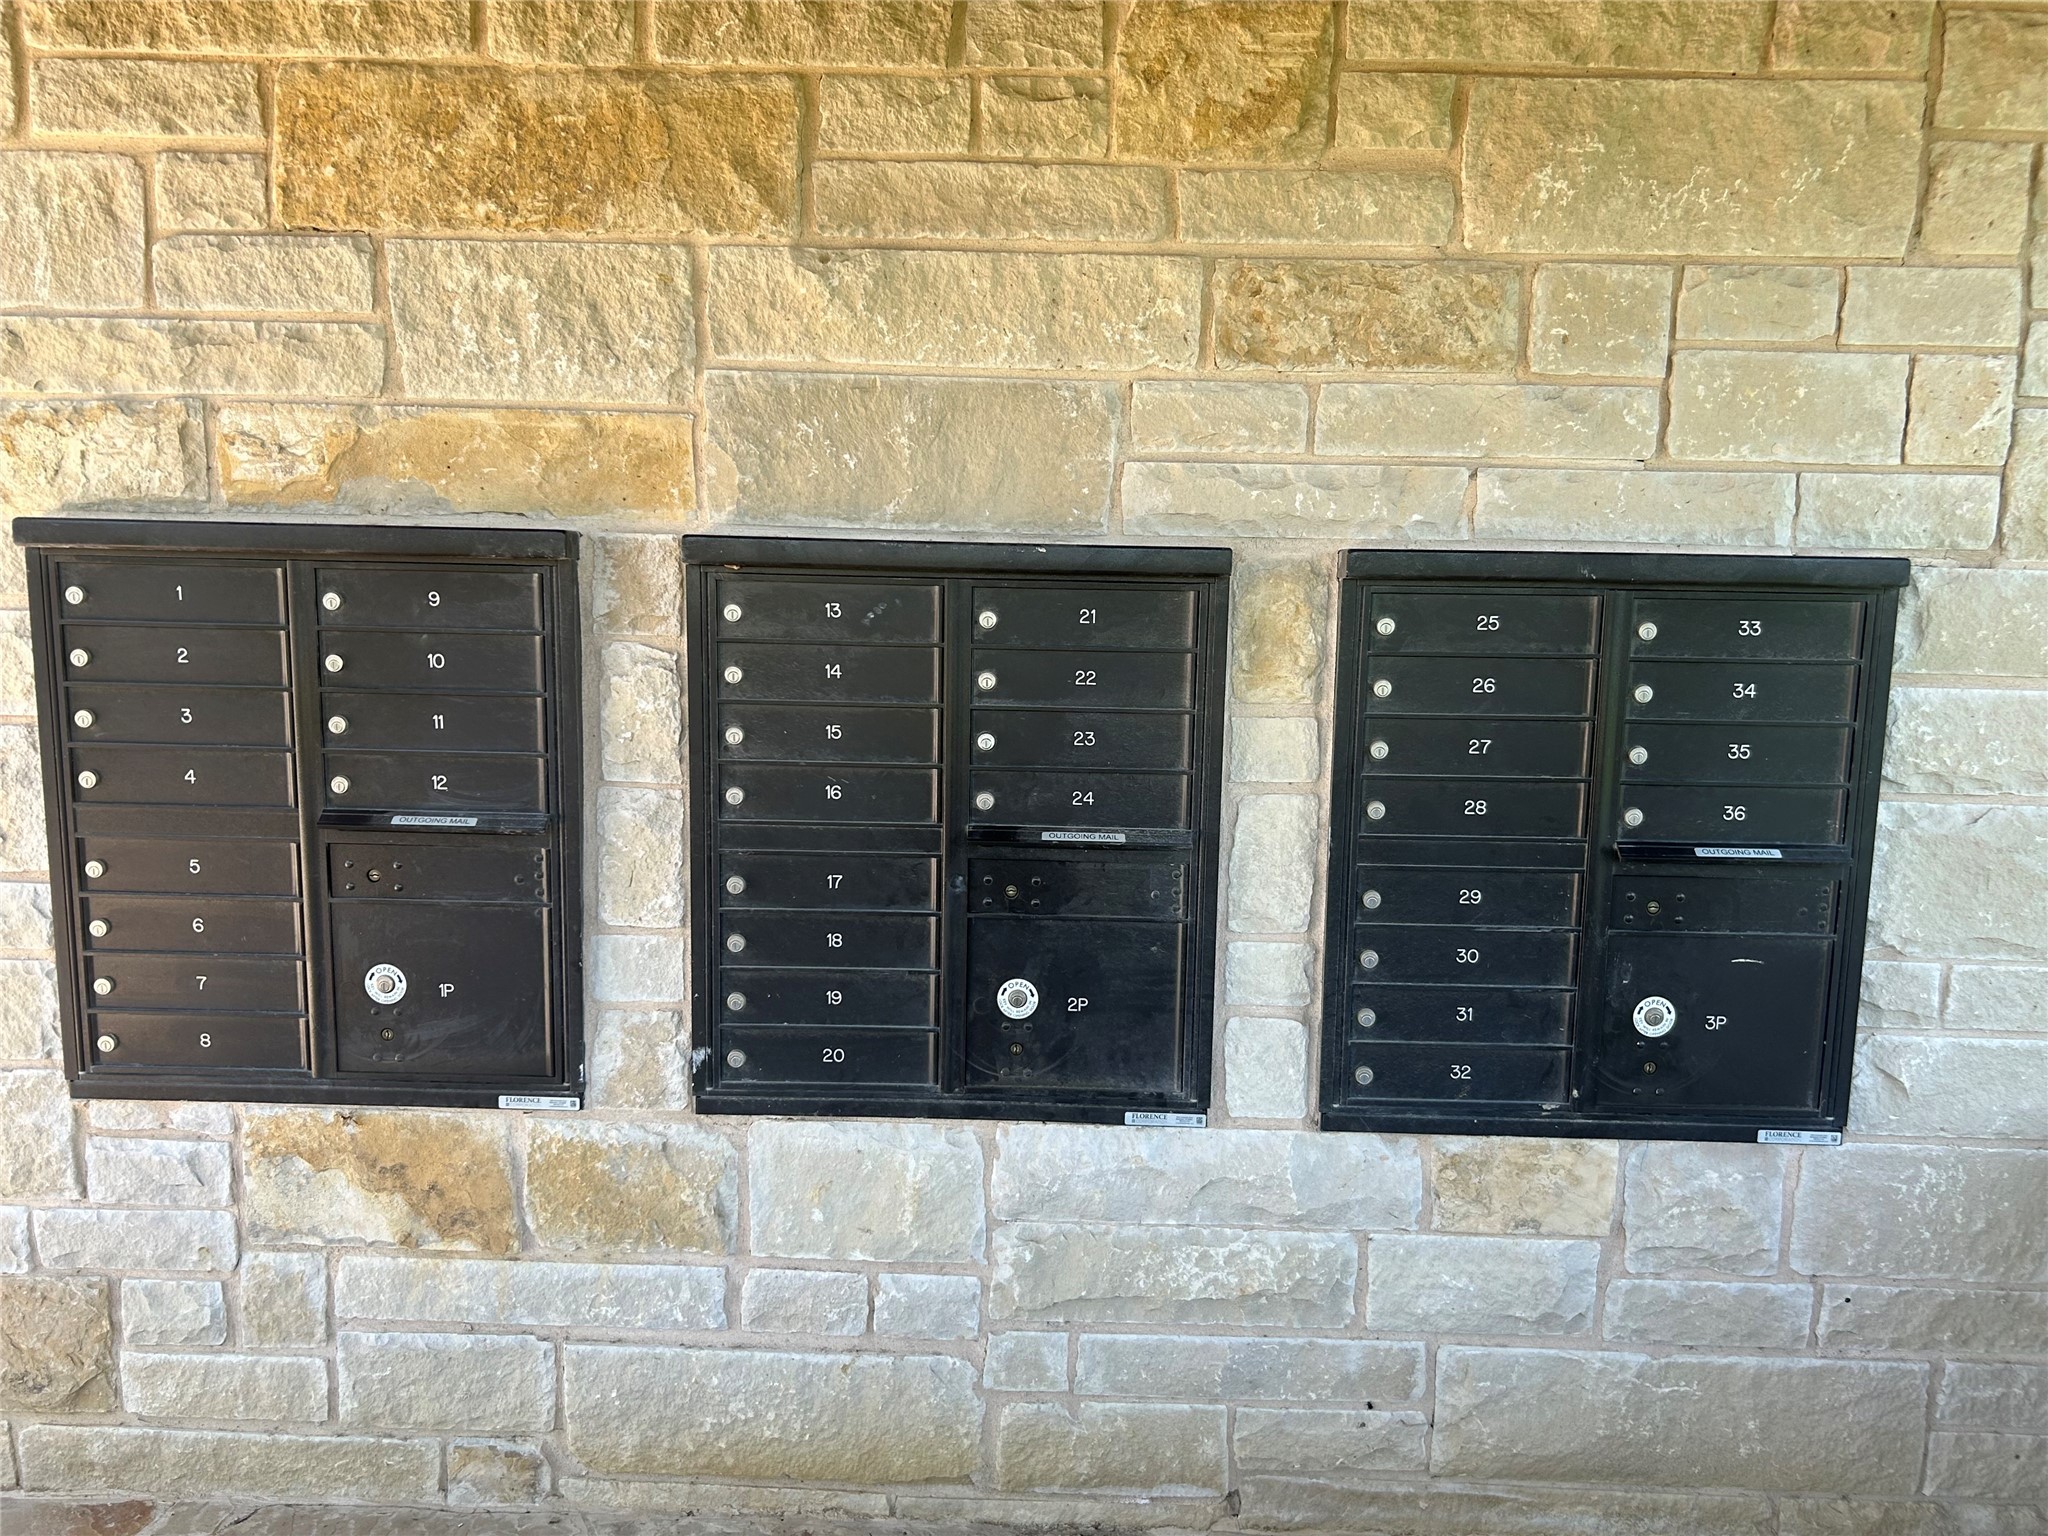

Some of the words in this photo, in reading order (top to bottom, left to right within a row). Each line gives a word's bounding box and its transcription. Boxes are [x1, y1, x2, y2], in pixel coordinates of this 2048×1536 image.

[175, 585, 183, 601] 1
[428, 591, 441, 607] 9
[824, 602, 842, 619] 13
[1079, 608, 1096, 624] 21
[1476, 615, 1500, 631] 25
[1738, 620, 1762, 637] 33
[177, 647, 189, 664] 2
[427, 653, 445, 669] 10
[824, 663, 843, 679] 14
[1075, 670, 1097, 686] 22
[1472, 677, 1496, 693] 26
[1732, 683, 1757, 699] 34
[180, 708, 193, 724] 3
[432, 714, 444, 730] 11
[825, 724, 842, 740] 15
[1073, 731, 1096, 746] 23
[1468, 739, 1492, 755] 27
[1727, 744, 1751, 760] 35
[184, 769, 197, 785] 4
[431, 775, 449, 792] 12
[825, 784, 842, 800] 16
[1072, 791, 1095, 806] 24
[1464, 799, 1487, 815] 28
[1722, 805, 1746, 821] 36
[399, 816, 446, 824] OUTGOING
[1048, 832, 1096, 840] OUTGOING
[1701, 848, 1751, 856] OUTGOING
[1753, 849, 1775, 857] MAIL
[189, 858, 201, 874] 5
[826, 874, 843, 889] 17
[1459, 889, 1482, 905] 29
[192, 917, 205, 933] 6
[826, 933, 843, 948] 18
[1455, 948, 1479, 964] 30
[375, 966, 397, 976] OPEN
[195, 975, 207, 991] 7
[438, 983, 455, 998] 1P
[1008, 981, 1030, 990] OPEN
[826, 990, 843, 1005] 19
[1067, 997, 1089, 1012] 2P
[1644, 999, 1667, 1008] OPEN
[1455, 1006, 1473, 1022] 31
[1704, 1015, 1727, 1030] 3P
[199, 1033, 212, 1048] 8
[822, 1048, 845, 1063] 20
[1450, 1064, 1472, 1080] 32
